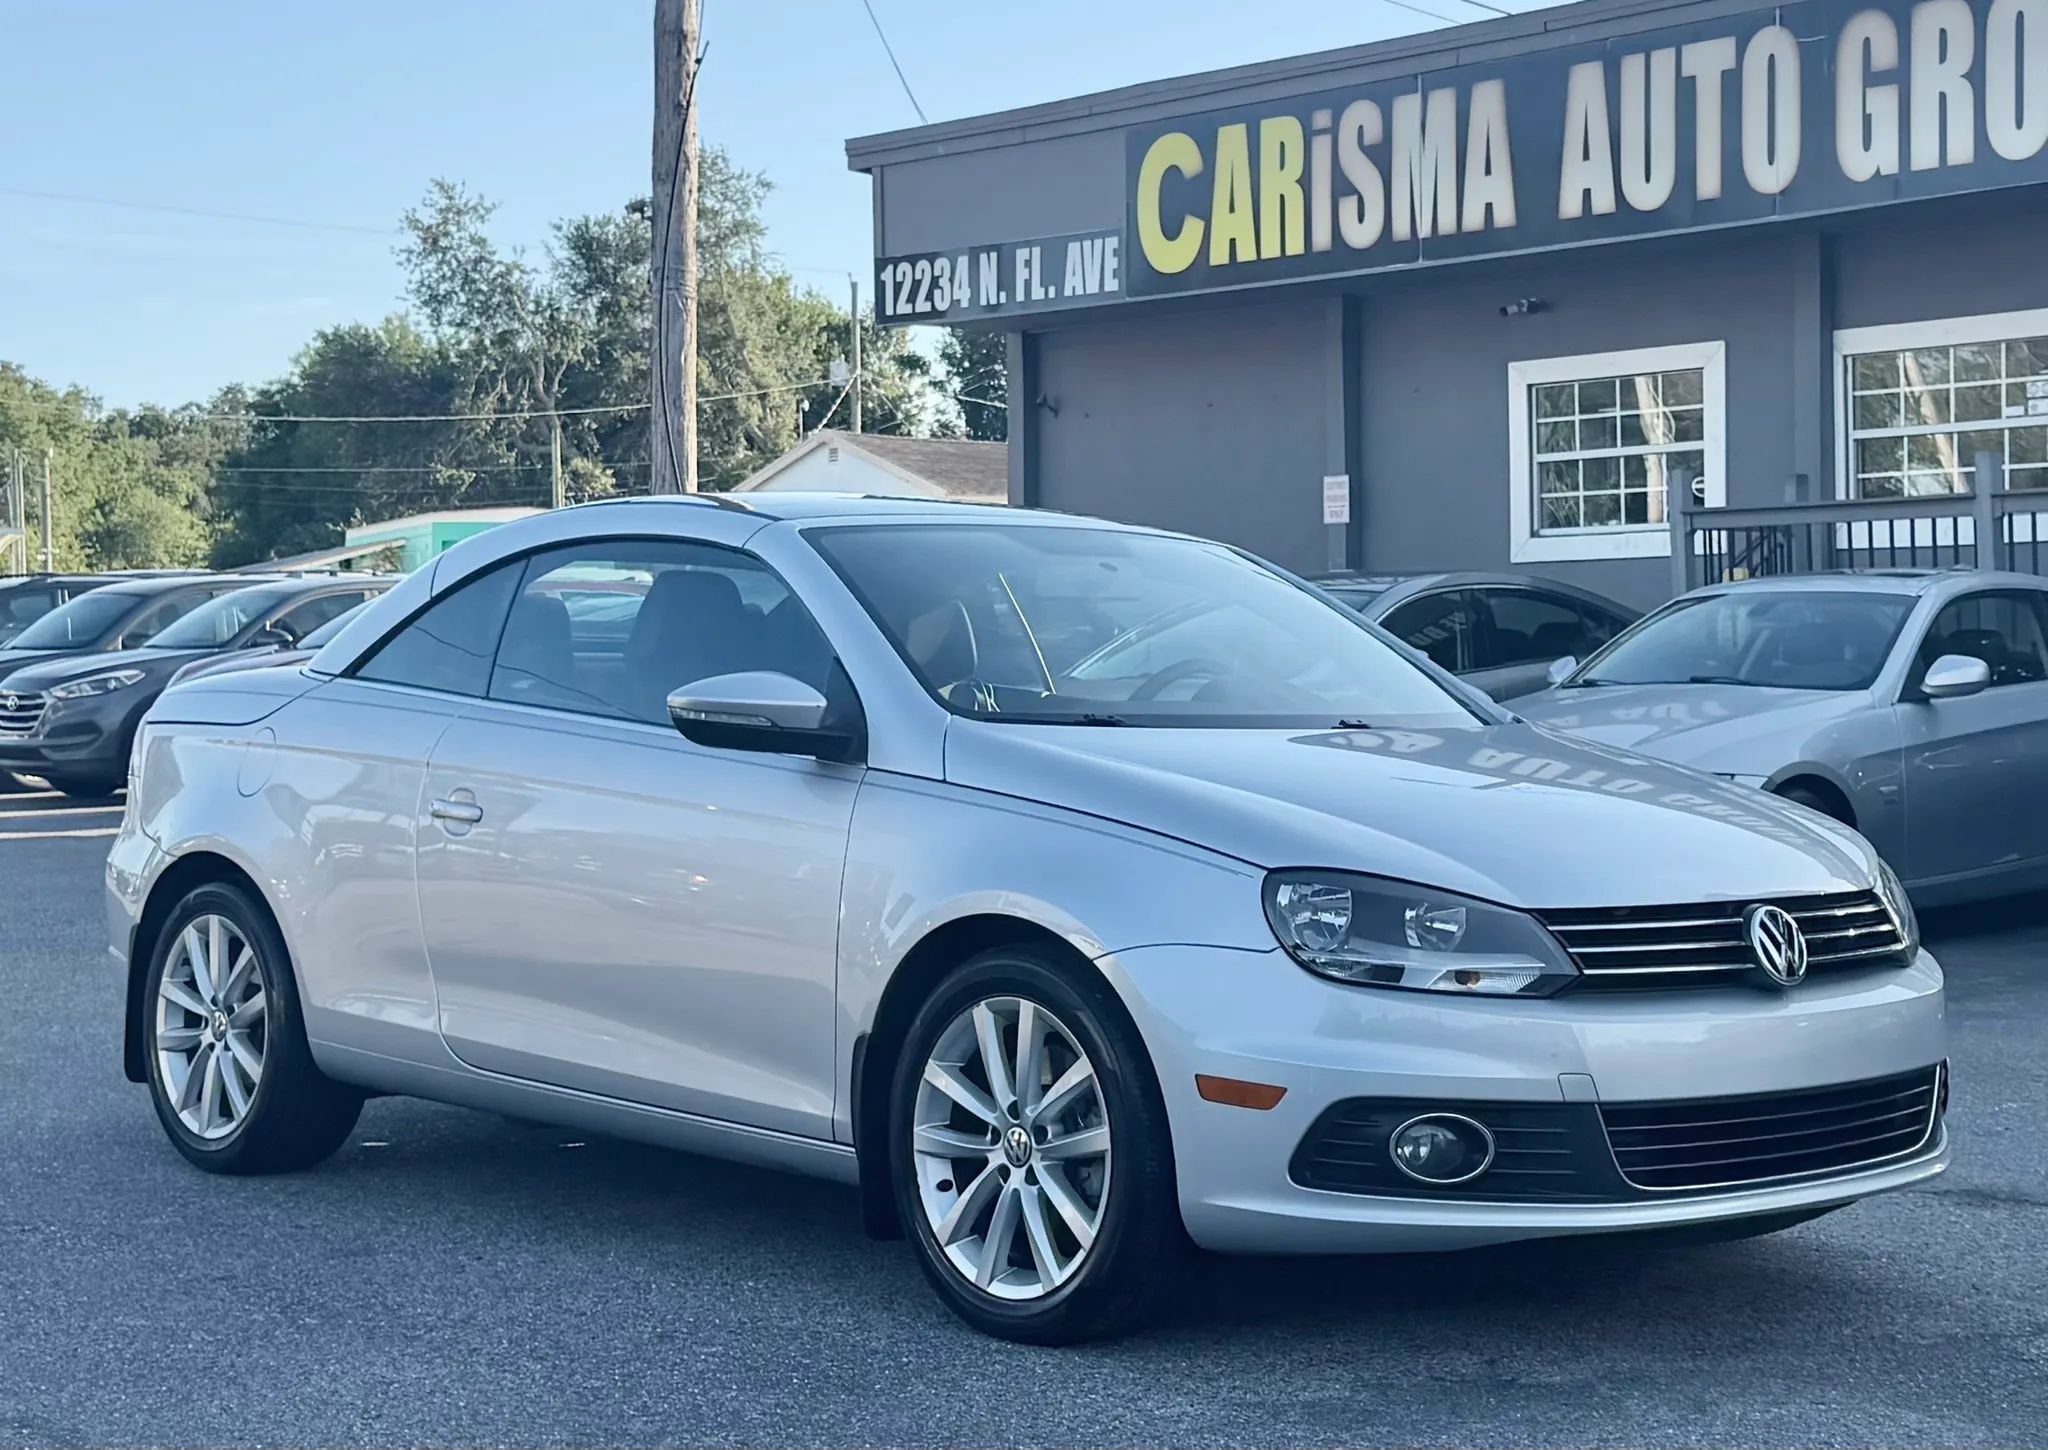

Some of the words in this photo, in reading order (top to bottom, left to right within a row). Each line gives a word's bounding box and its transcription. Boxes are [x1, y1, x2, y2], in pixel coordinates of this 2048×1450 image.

[1558, 25, 1801, 220] AUTO
[1836, 0, 2048, 183] GRO
[880, 255, 971, 316] 12234
[979, 252, 1006, 306] N.
[1016, 246, 1056, 302] FL.
[1063, 236, 1120, 297] AVE
